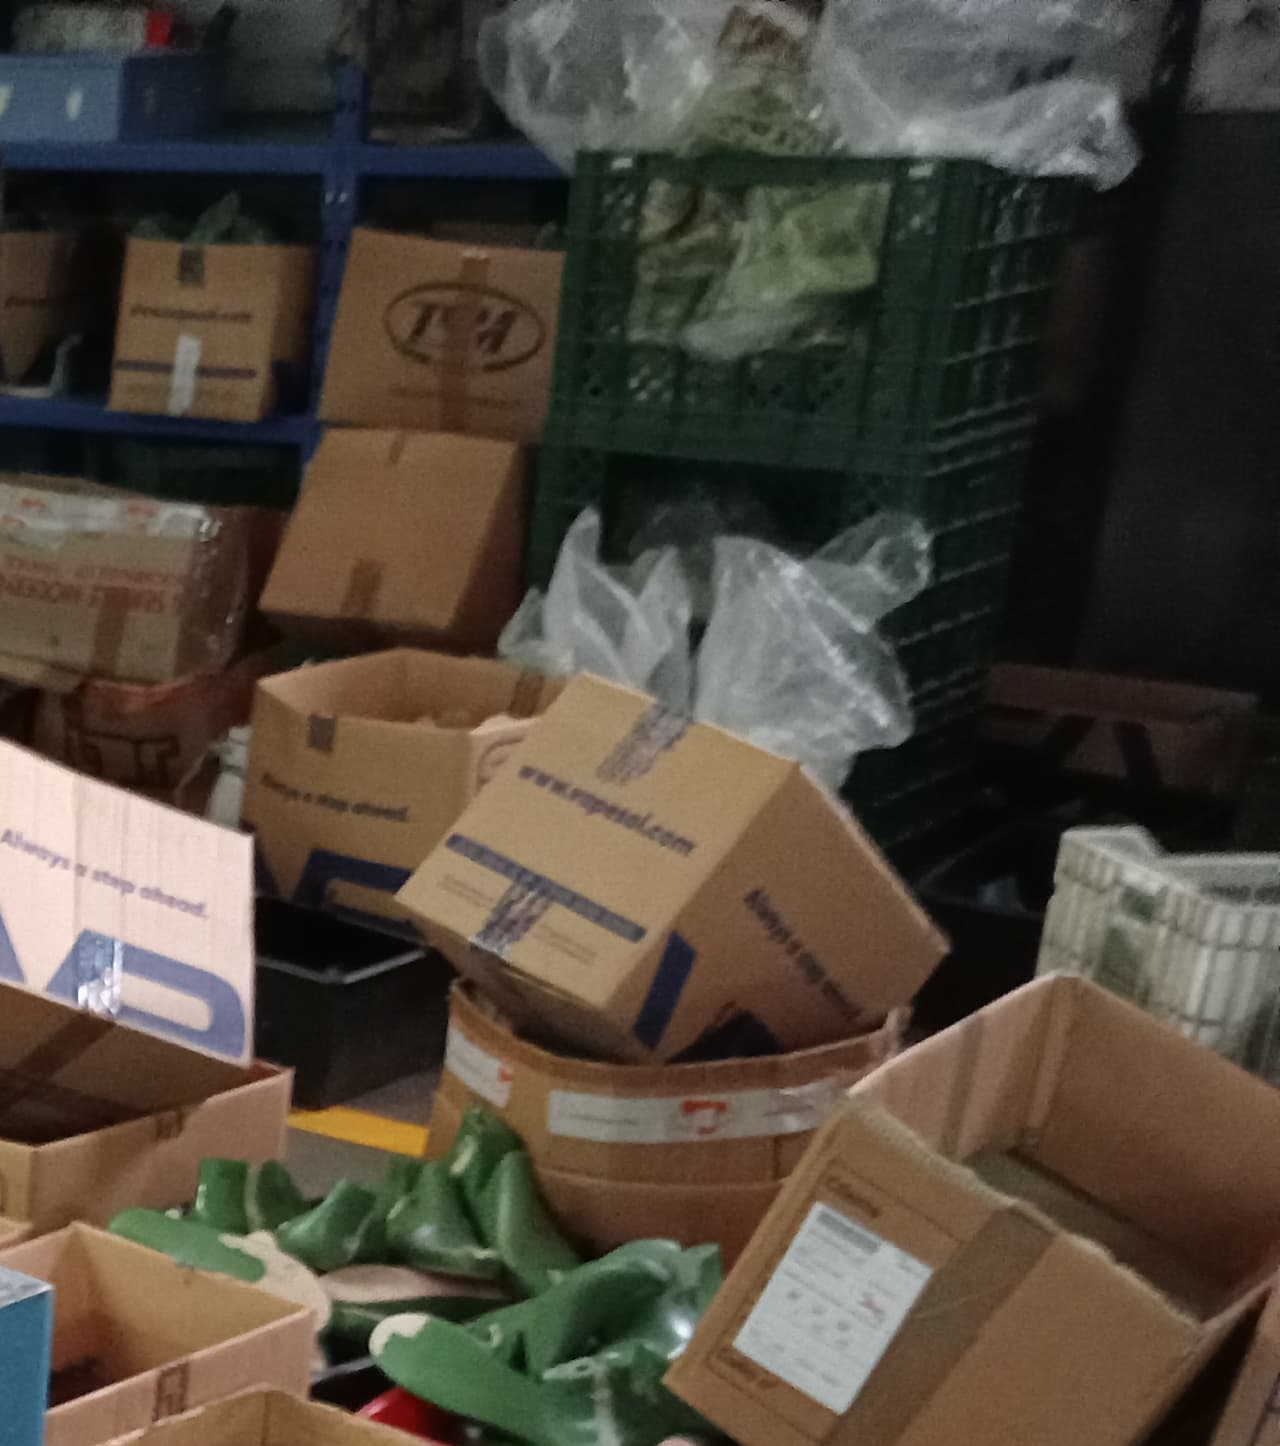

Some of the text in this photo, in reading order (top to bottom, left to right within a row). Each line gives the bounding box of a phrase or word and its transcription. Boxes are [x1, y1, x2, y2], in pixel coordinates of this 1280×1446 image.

[0, 828, 71, 870] Always
[74, 861, 89, 878] a
[92, 868, 137, 896] step
